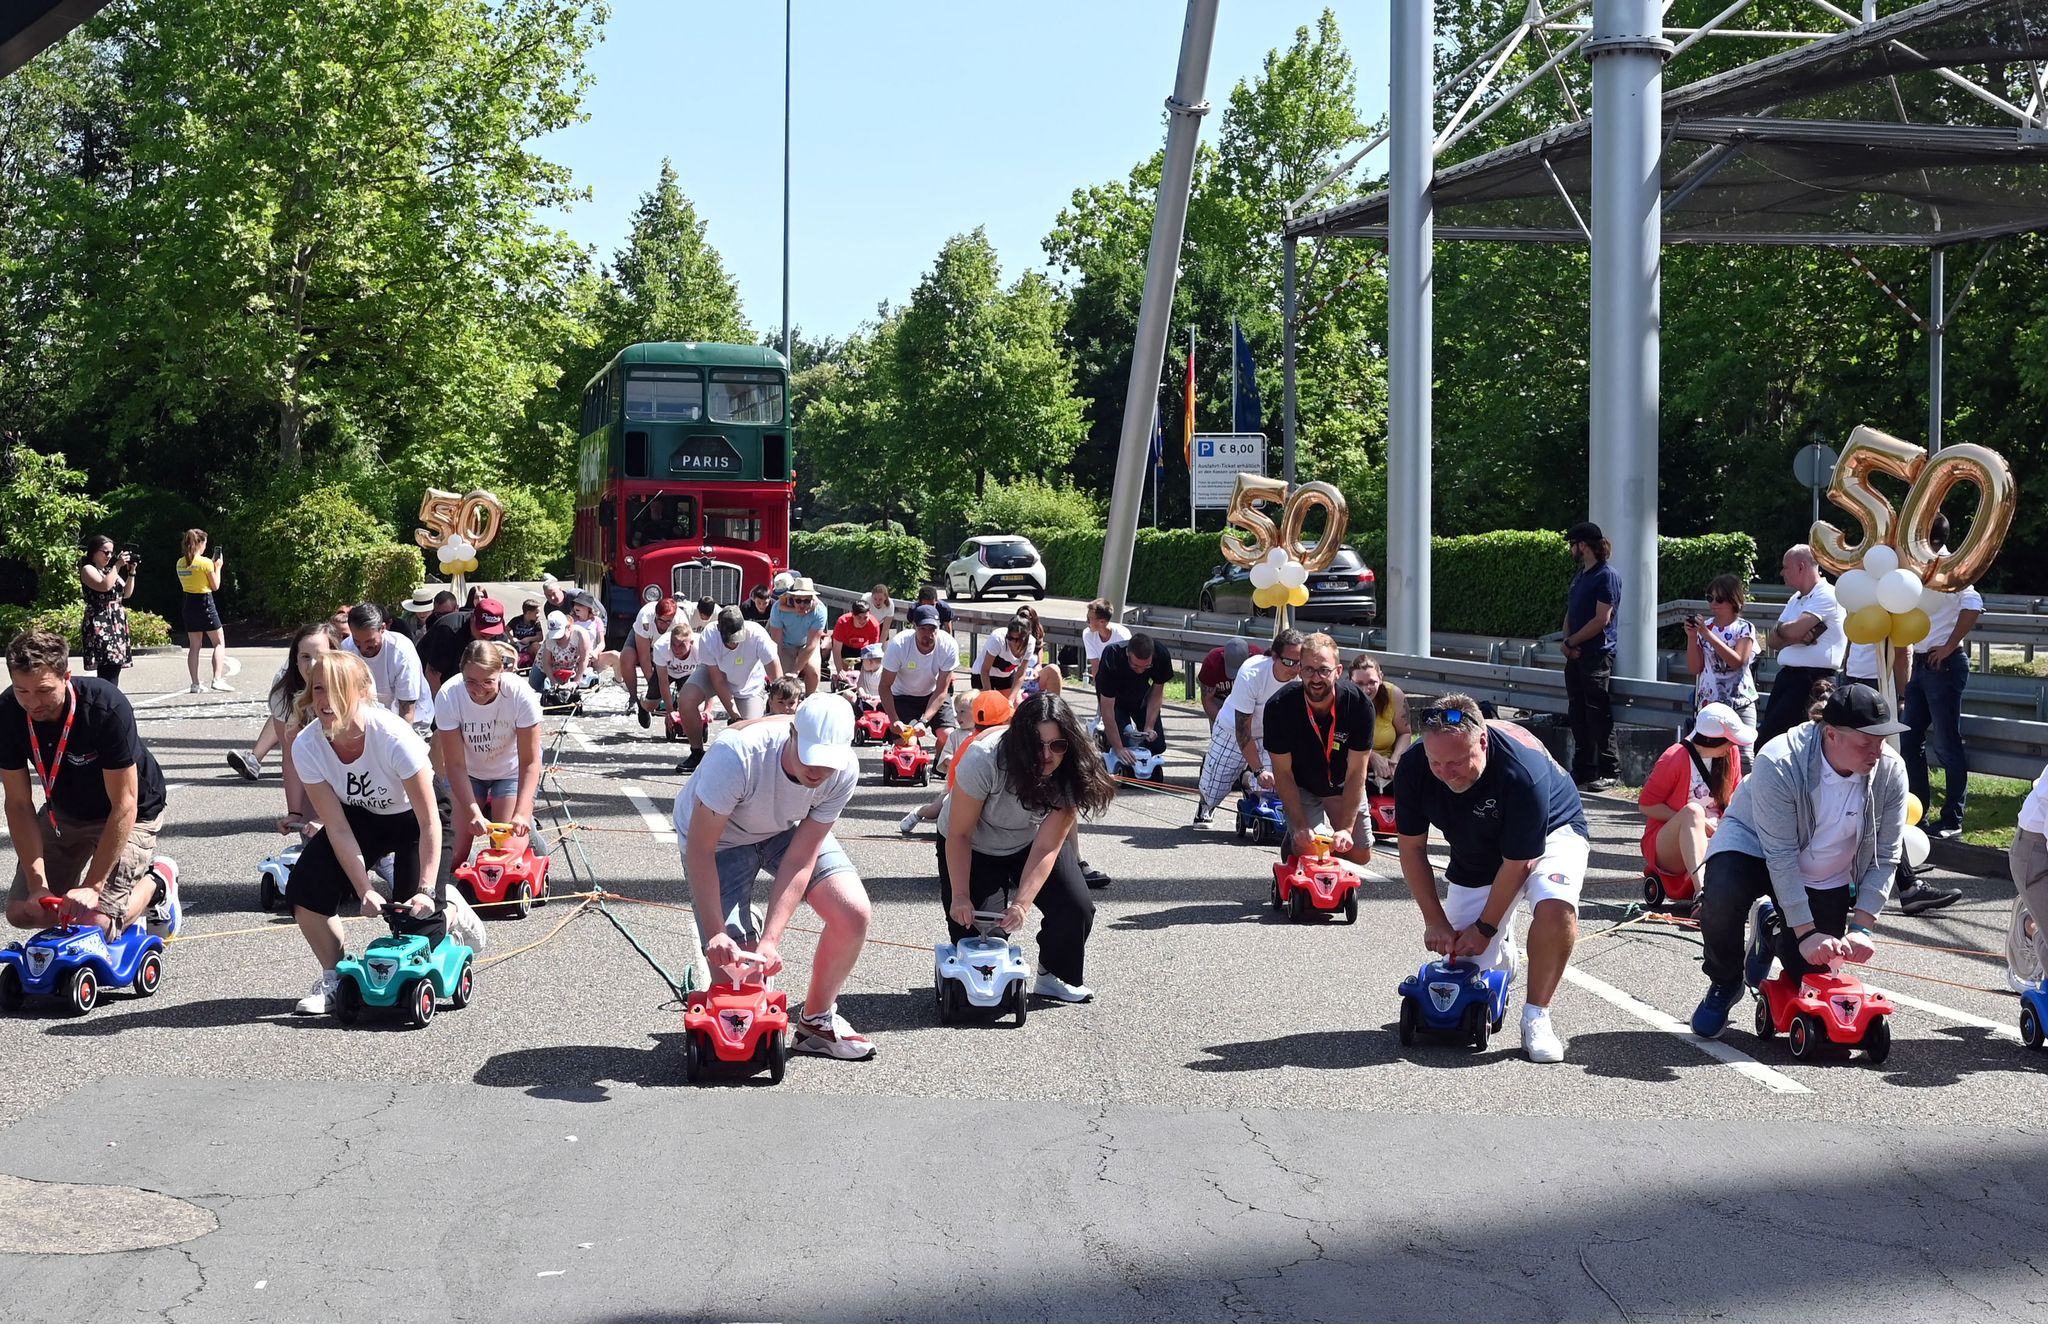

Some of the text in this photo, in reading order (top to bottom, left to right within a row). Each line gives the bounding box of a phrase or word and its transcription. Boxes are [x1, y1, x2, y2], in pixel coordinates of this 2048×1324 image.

[682, 455, 729, 468] PARIS
[1219, 444, 1226, 453] €
[1229, 444, 1254, 456] 8,00
[415, 487, 503, 551] 50
[1221, 472, 1349, 572] 50
[1809, 424, 2017, 592] 50
[347, 771, 375, 797] BE
